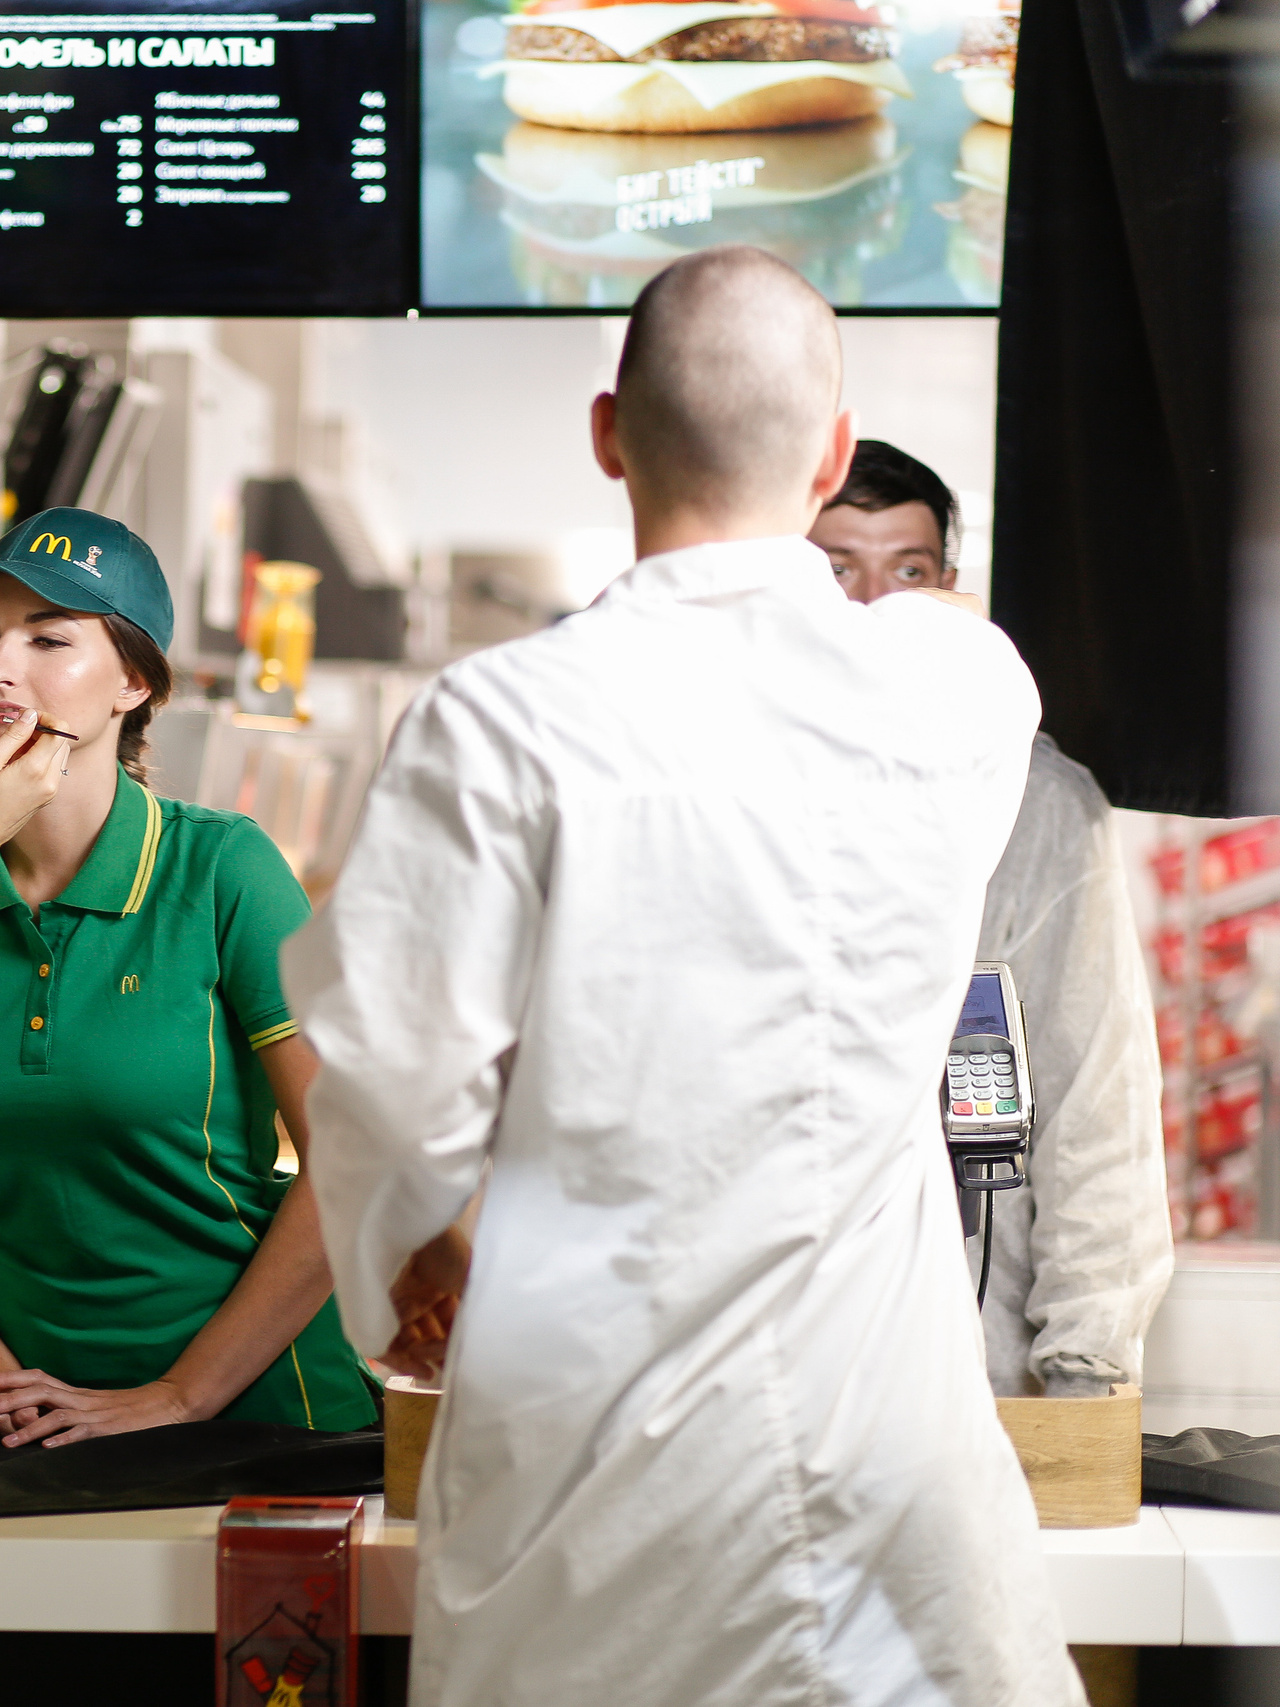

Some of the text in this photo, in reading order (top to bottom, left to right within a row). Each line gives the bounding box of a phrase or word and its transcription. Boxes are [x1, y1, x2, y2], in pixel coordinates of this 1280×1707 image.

[107, 38, 137, 67] И
[137, 37, 275, 68] САЛАТЫ
[616, 170, 664, 203] БИГ
[615, 193, 713, 233] ОСТРЫЙ
